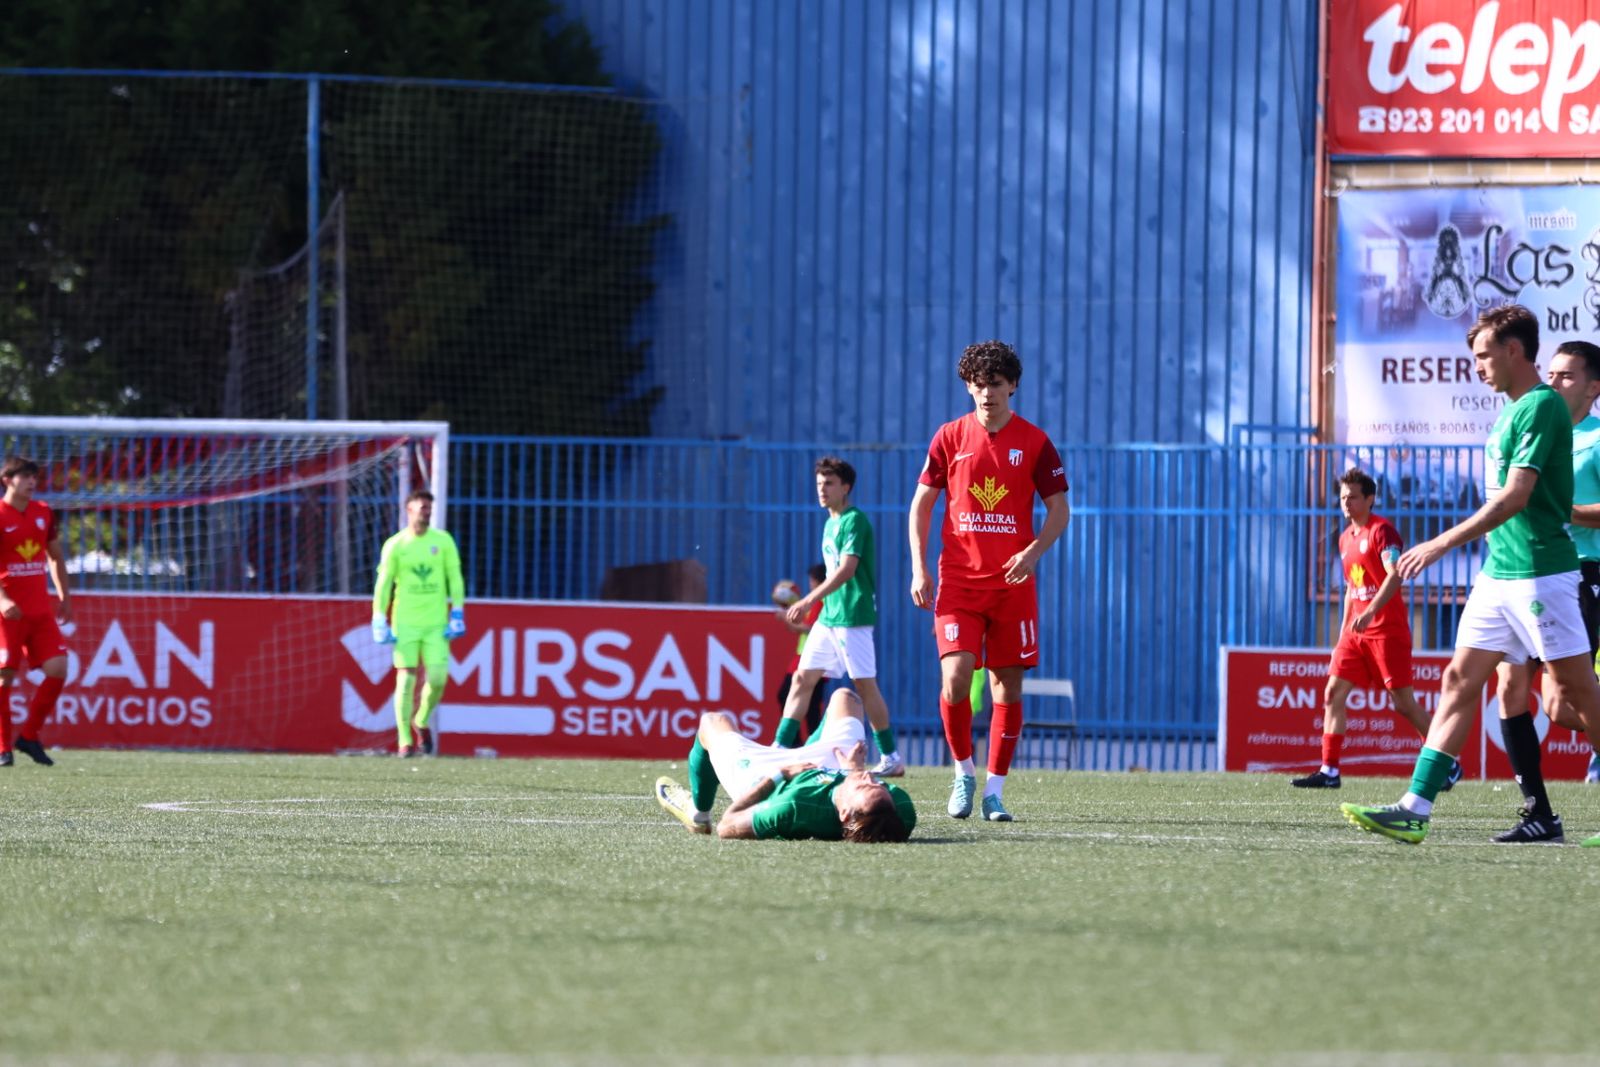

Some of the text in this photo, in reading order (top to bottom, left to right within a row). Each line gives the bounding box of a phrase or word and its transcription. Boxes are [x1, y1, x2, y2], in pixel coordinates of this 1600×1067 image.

[1388, 106, 1433, 133] 923
[1439, 106, 1485, 133] 201
[1494, 106, 1542, 133] 014
[1473, 224, 1575, 308] Las
[1546, 305, 1580, 332] del
[1382, 357, 1485, 384] RESER
[1440, 422, 1476, 434] BODAS
[959, 511, 1017, 525] CAJA RURAL
[959, 523, 1017, 534] DE SALAMANCA
[1020, 619, 1035, 648] 11
[1257, 684, 1317, 709] SAN
[9, 695, 213, 727] SRVICIOS
[562, 706, 763, 739] SERVICS
